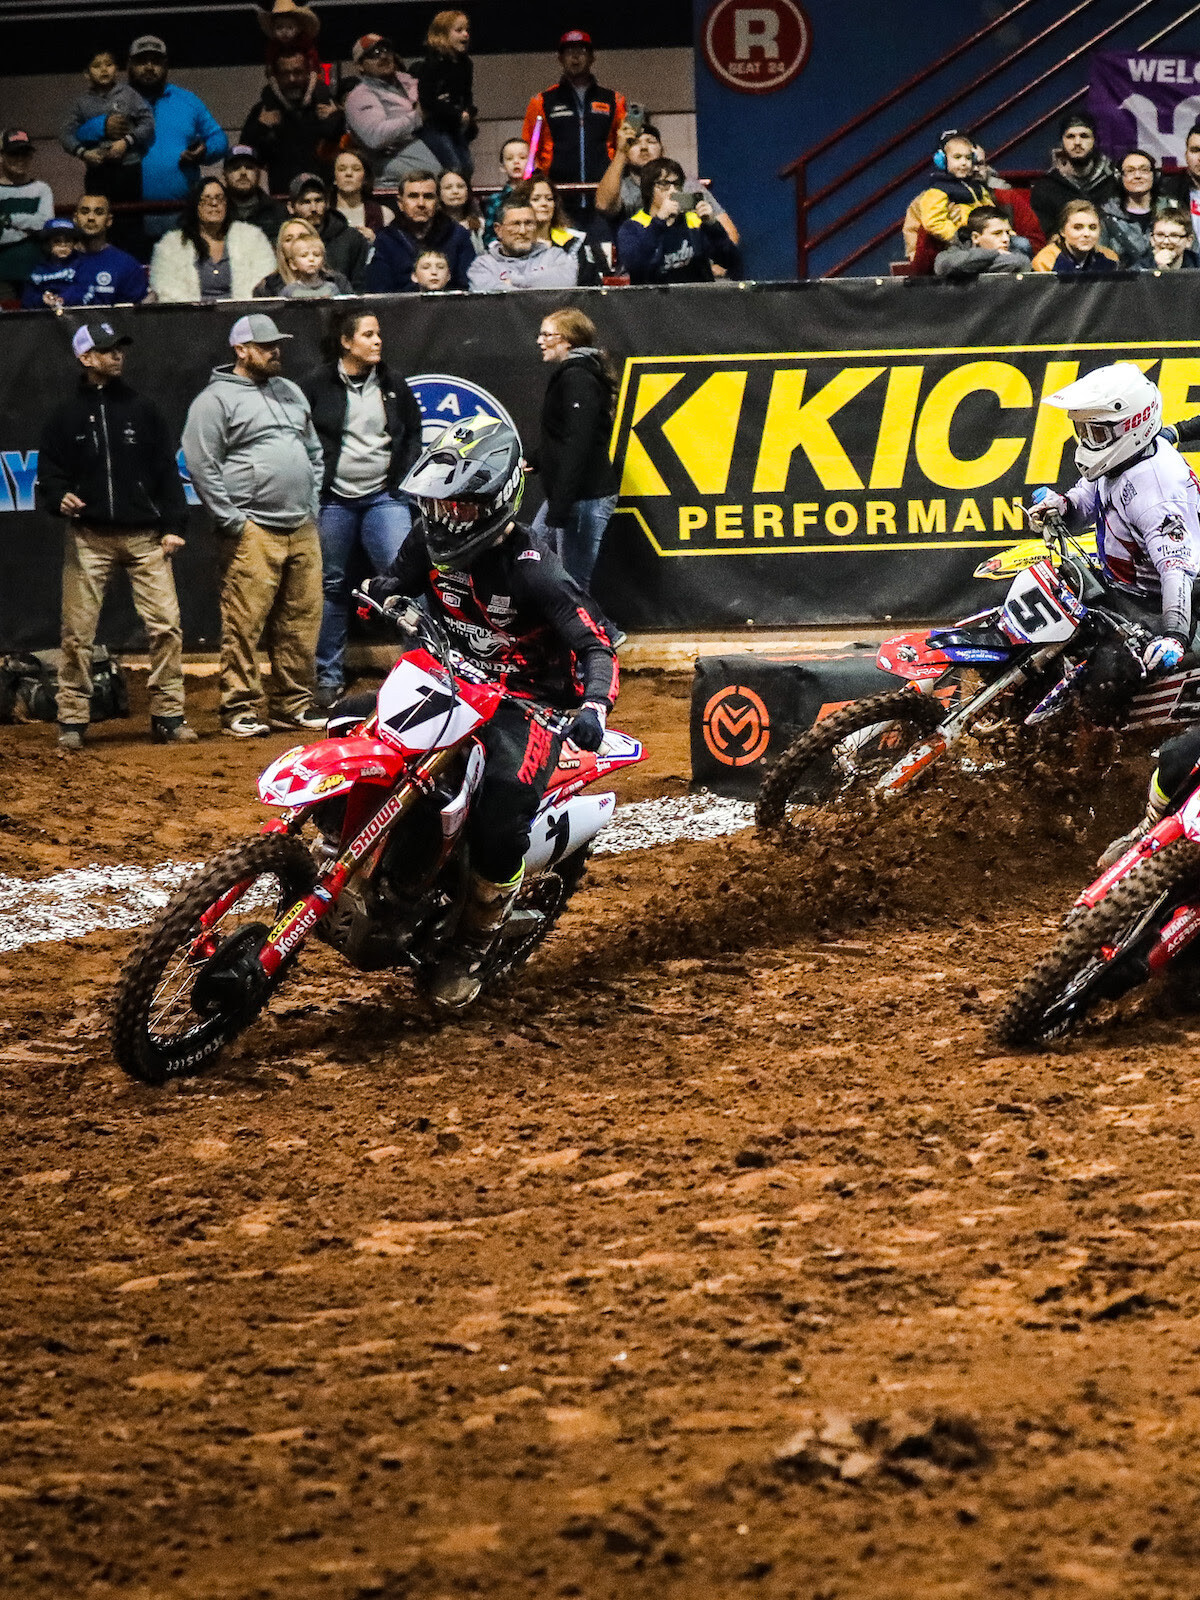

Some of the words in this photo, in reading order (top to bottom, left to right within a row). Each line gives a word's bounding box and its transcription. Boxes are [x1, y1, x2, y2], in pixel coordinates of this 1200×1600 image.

[735, 8, 779, 59] R
[728, 61, 761, 75] SEAT
[678, 497, 1024, 541] PERFORMAN
[1007, 585, 1062, 635] 5
[469, 653, 521, 673] ONDA
[351, 797, 400, 857] SHOWA
[270, 902, 304, 942] ACERBIS
[273, 908, 317, 960] Hoosier
